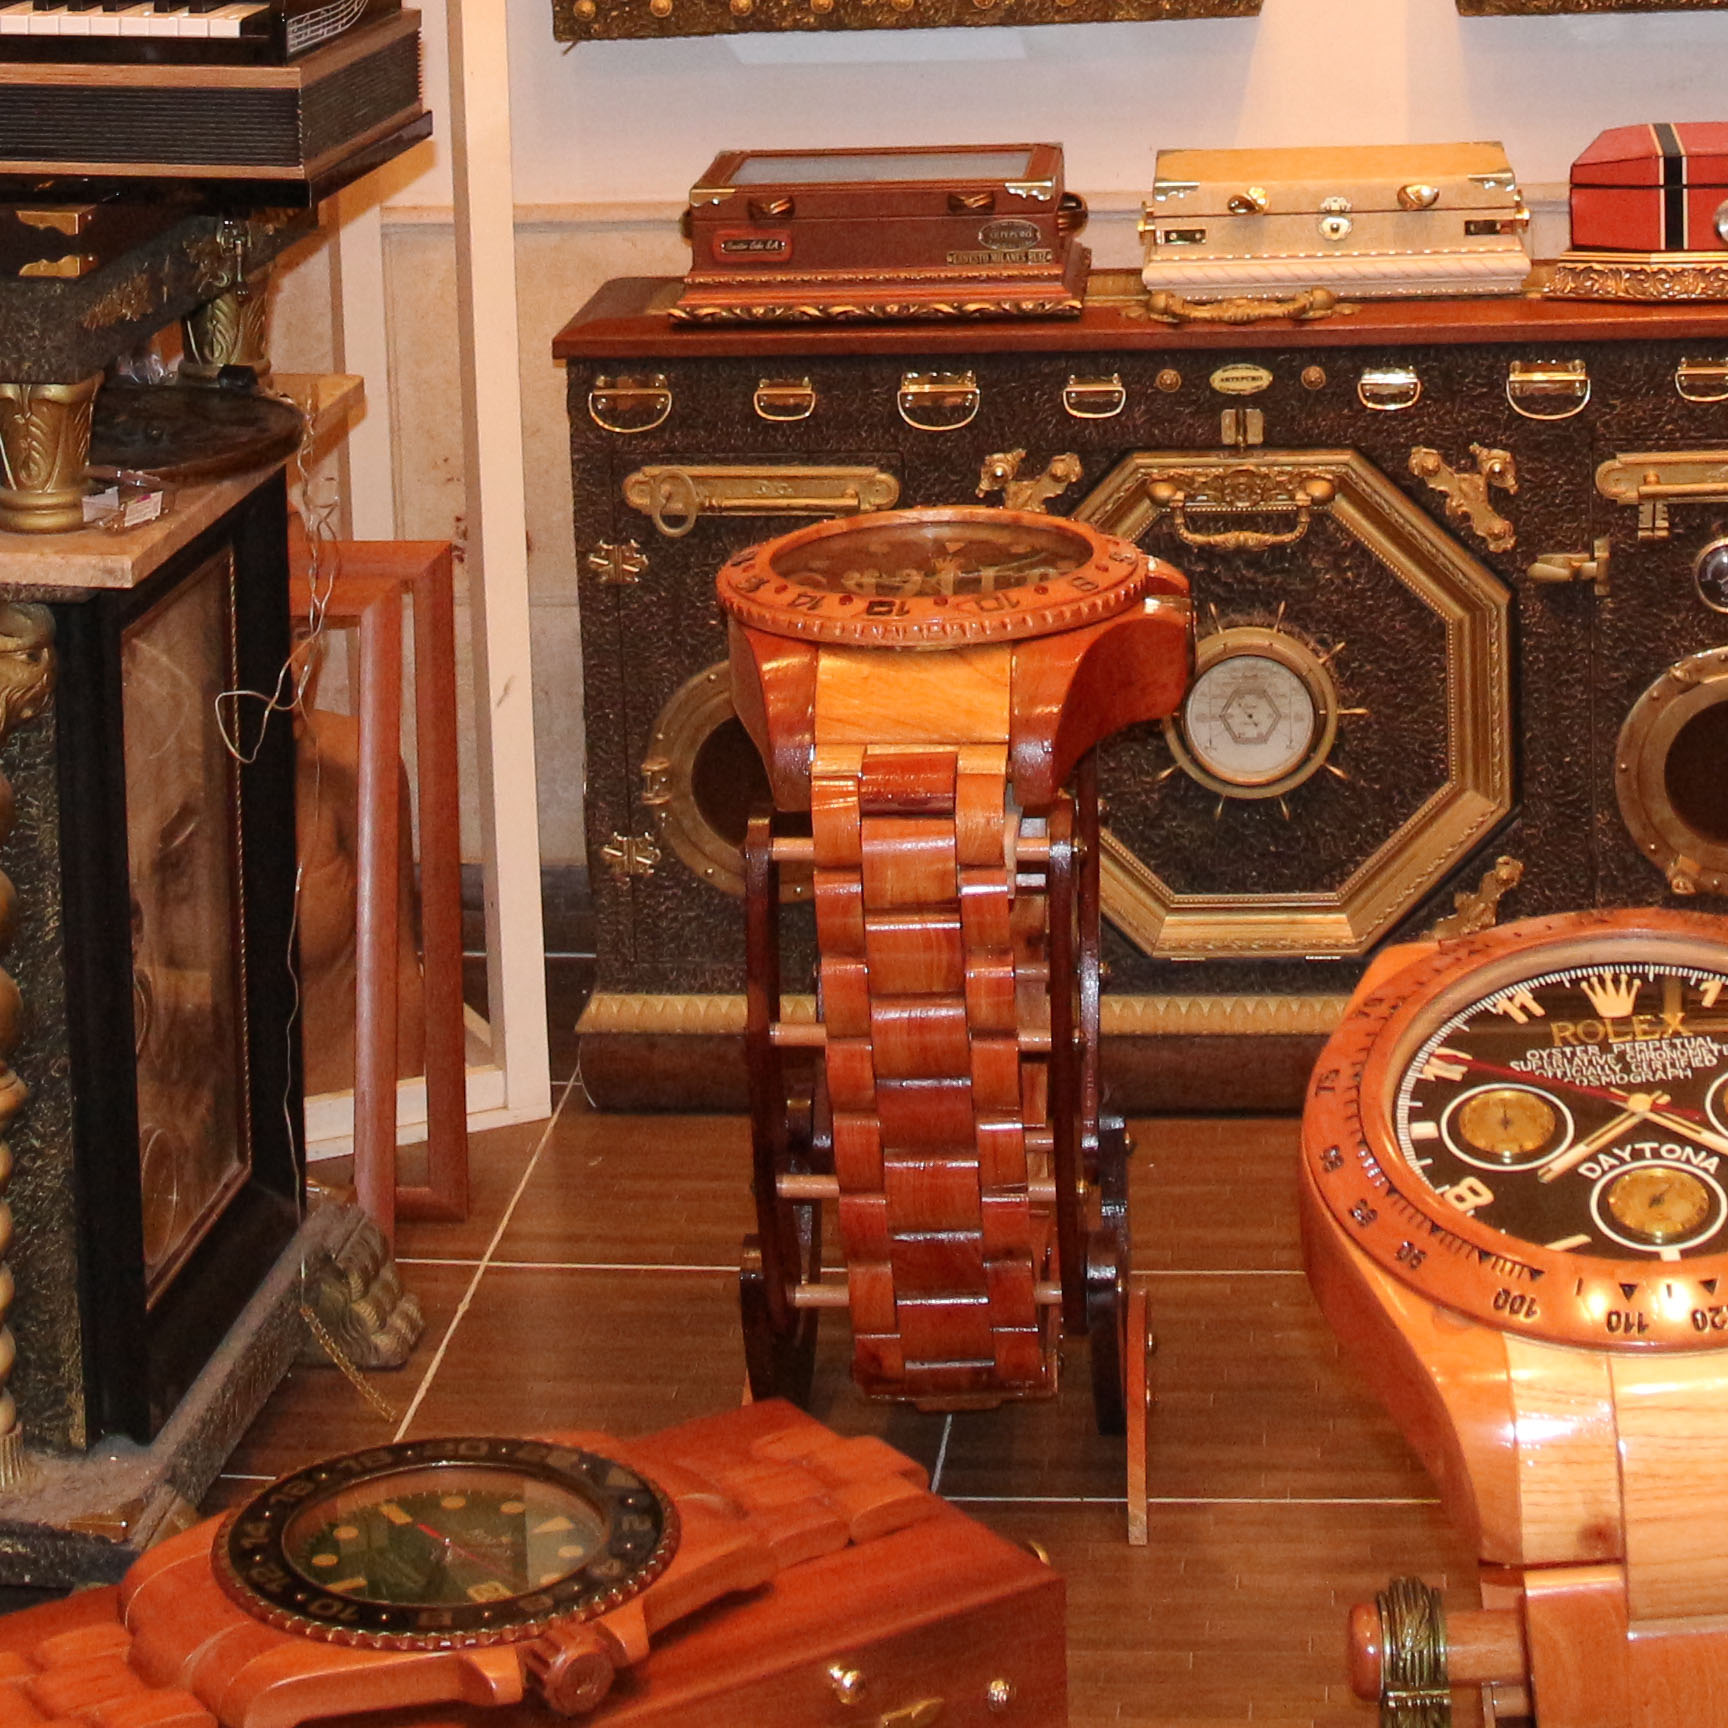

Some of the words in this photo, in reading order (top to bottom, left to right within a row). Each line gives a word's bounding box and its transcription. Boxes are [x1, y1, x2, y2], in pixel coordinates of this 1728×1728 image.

[1550, 1011, 1694, 1047] ROLEX
[1509, 1053, 1617, 1073] SUPERLATIVE
[1525, 1044, 1601, 1063] OYSTER
[1613, 1035, 1715, 1055] PERPETUAL
[1630, 1055, 1719, 1073] CERTIFIED
[1577, 1141, 1722, 1180] DAYTONA
[1443, 1175, 1494, 1212] 8
[1492, 1286, 1540, 1321] 100
[1605, 1307, 1650, 1336] 110
